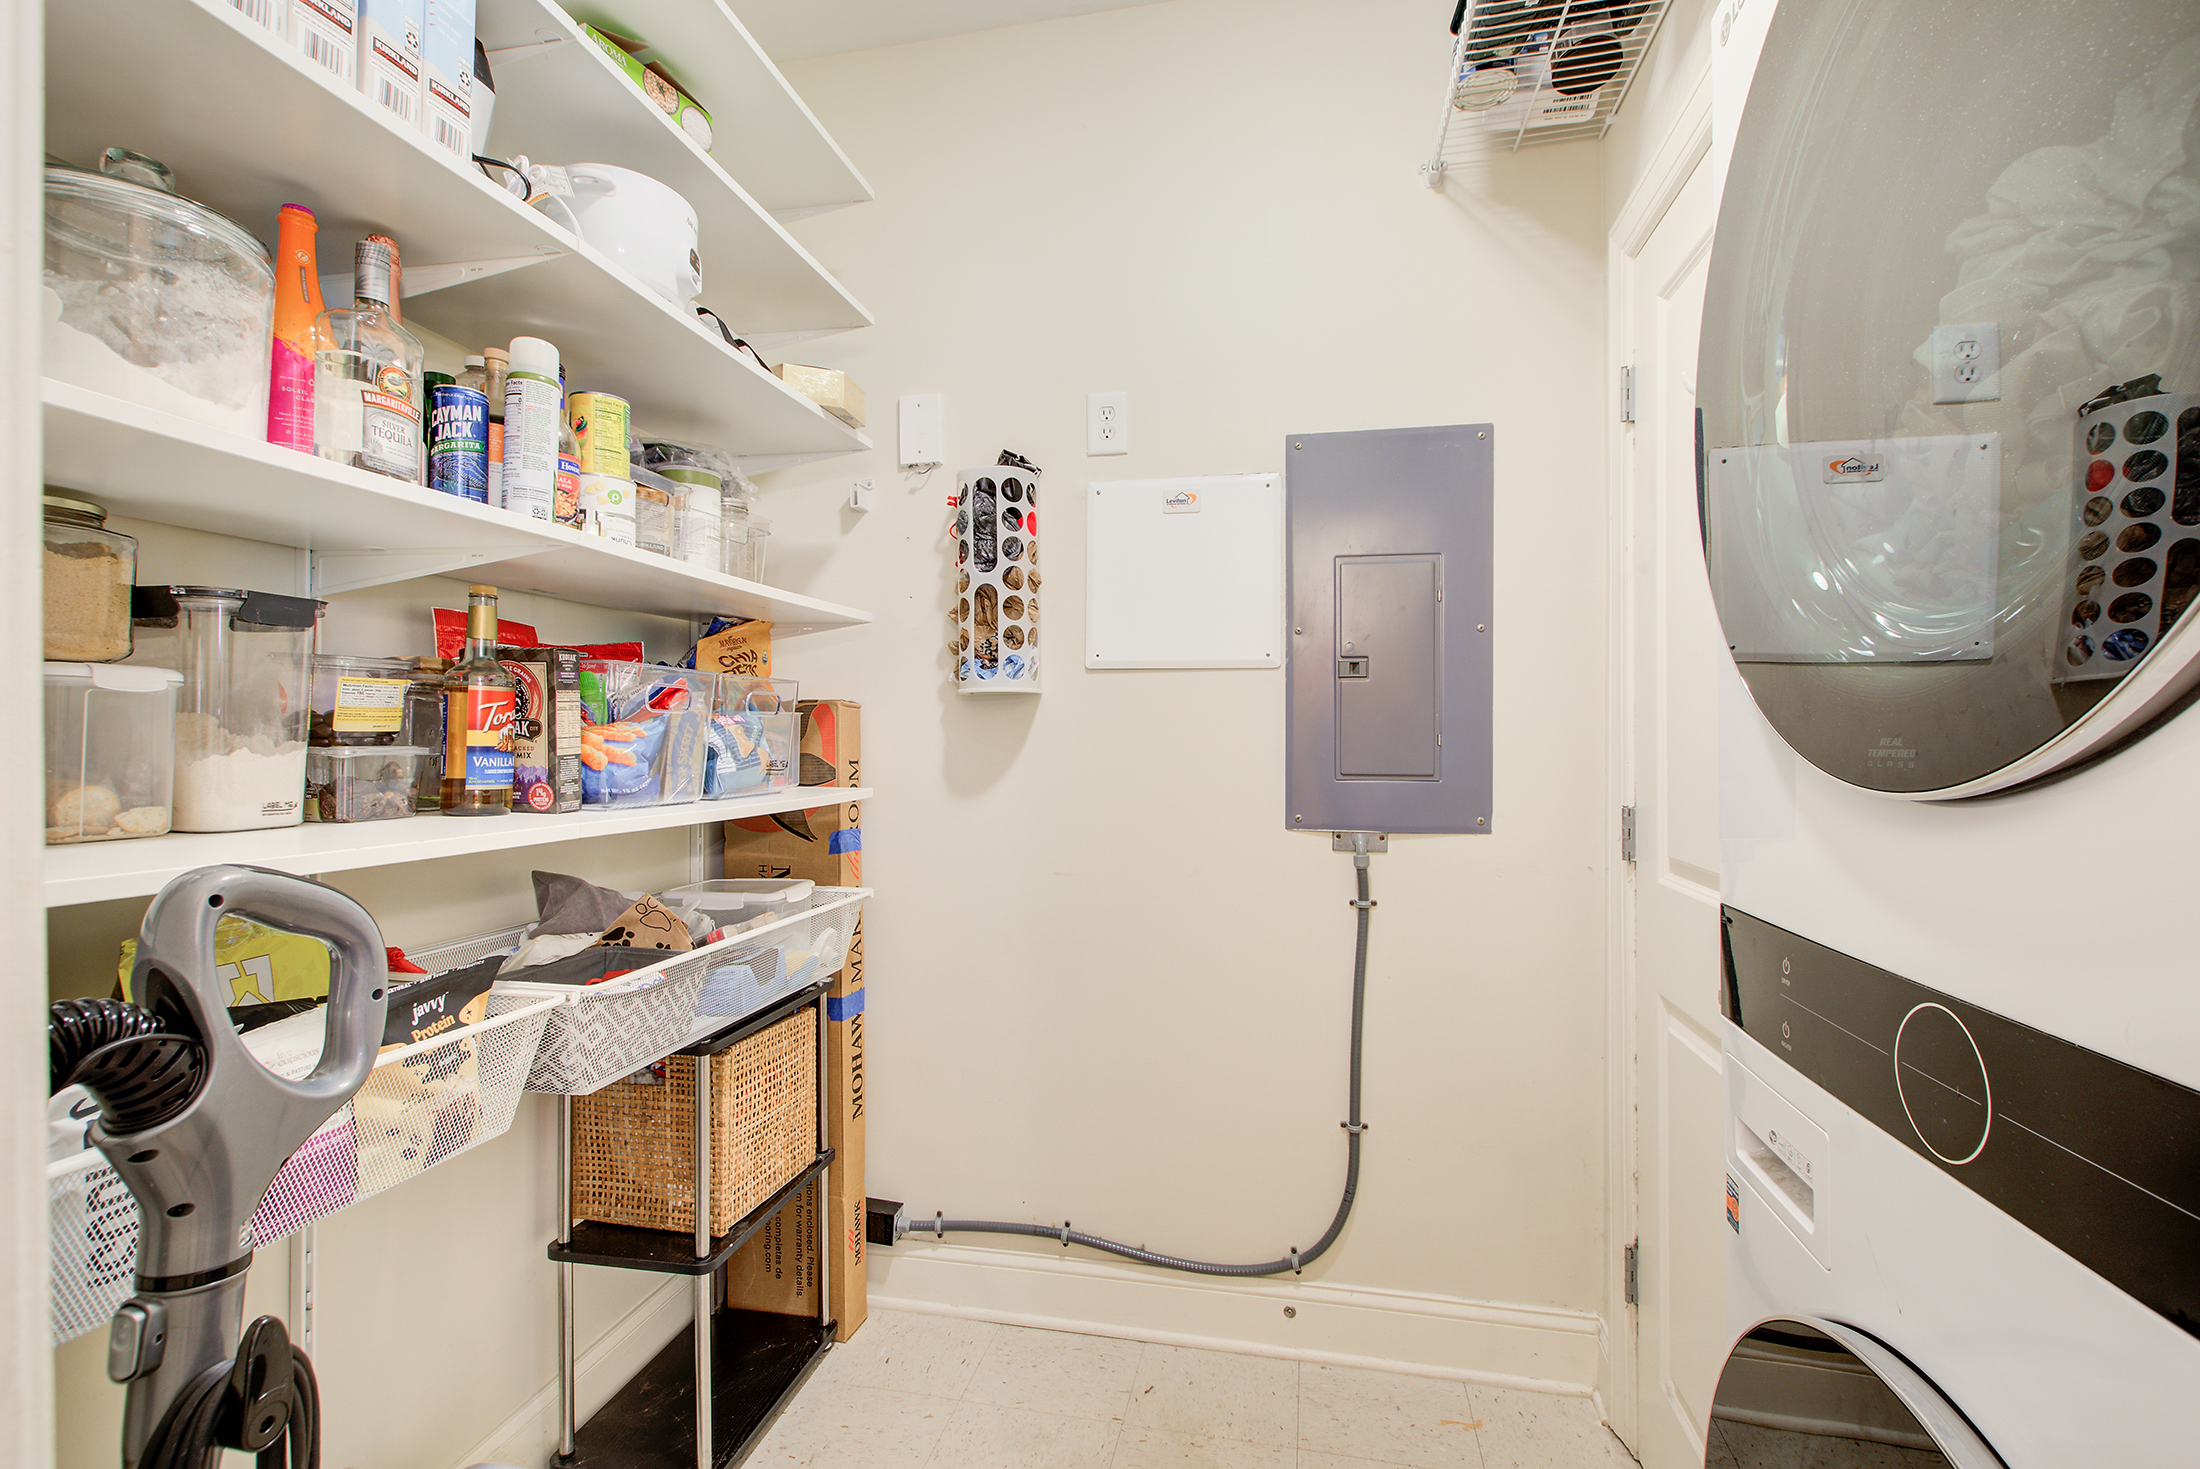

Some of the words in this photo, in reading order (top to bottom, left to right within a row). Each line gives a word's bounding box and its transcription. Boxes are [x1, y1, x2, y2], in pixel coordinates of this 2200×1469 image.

[374, 39, 418, 76] KIRKLAND
[591, 33, 628, 68] AROMA
[431, 79, 470, 113] KIRKLAND
[282, 386, 308, 395] SOLEIL
[363, 392, 420, 421] MARGARITAVILLE
[431, 405, 482, 428] CAYMAN
[371, 424, 413, 448] TEQUILA
[381, 420, 406, 435] SILVER
[718, 649, 758, 668] CHIA
[513, 667, 532, 684] GRAINS
[1868, 749, 1916, 758] TEMPERED
[1880, 738, 1902, 746] REAL
[1868, 761, 1914, 769] GLASS
[262, 801, 283, 810] LABEL
[284, 801, 294, 809] ME
[411, 994, 447, 1027] javvy
[411, 1013, 456, 1044] Protein
[278, 1048, 320, 1067] conscious
[291, 1063, 317, 1075] PASTURE-
[851, 1013, 864, 1122] MOHAW
[795, 1205, 804, 1218] for
[774, 1216, 782, 1266] completas
[794, 1220, 803, 1262] warranty
[806, 1209, 814, 1254] enclosed.
[775, 1268, 782, 1280] de
[795, 1264, 804, 1298] details.
[806, 1256, 815, 1288] Please
